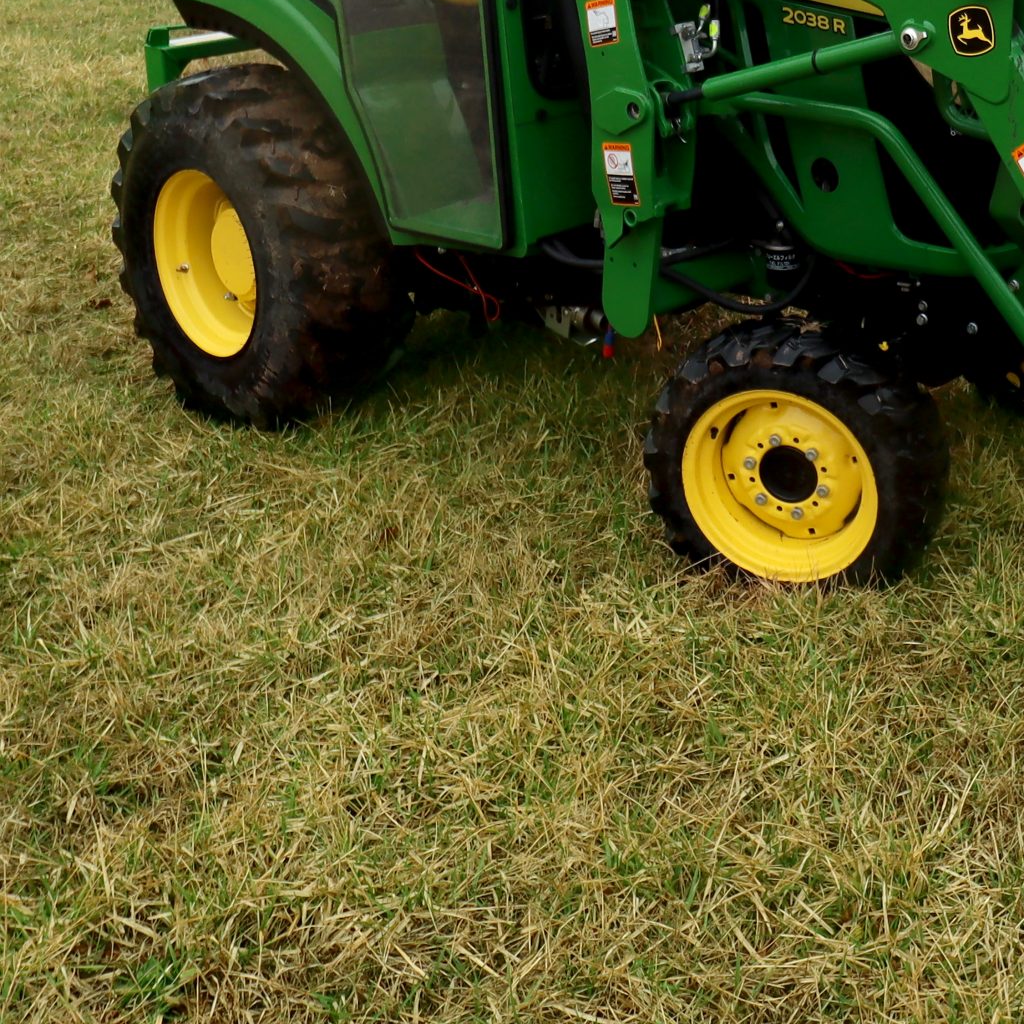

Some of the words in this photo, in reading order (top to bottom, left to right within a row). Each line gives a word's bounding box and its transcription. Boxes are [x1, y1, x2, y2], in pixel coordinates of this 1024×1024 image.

[782, 6, 830, 30] 2038
[833, 17, 846, 34] R
[608, 144, 630, 152] WARNING
